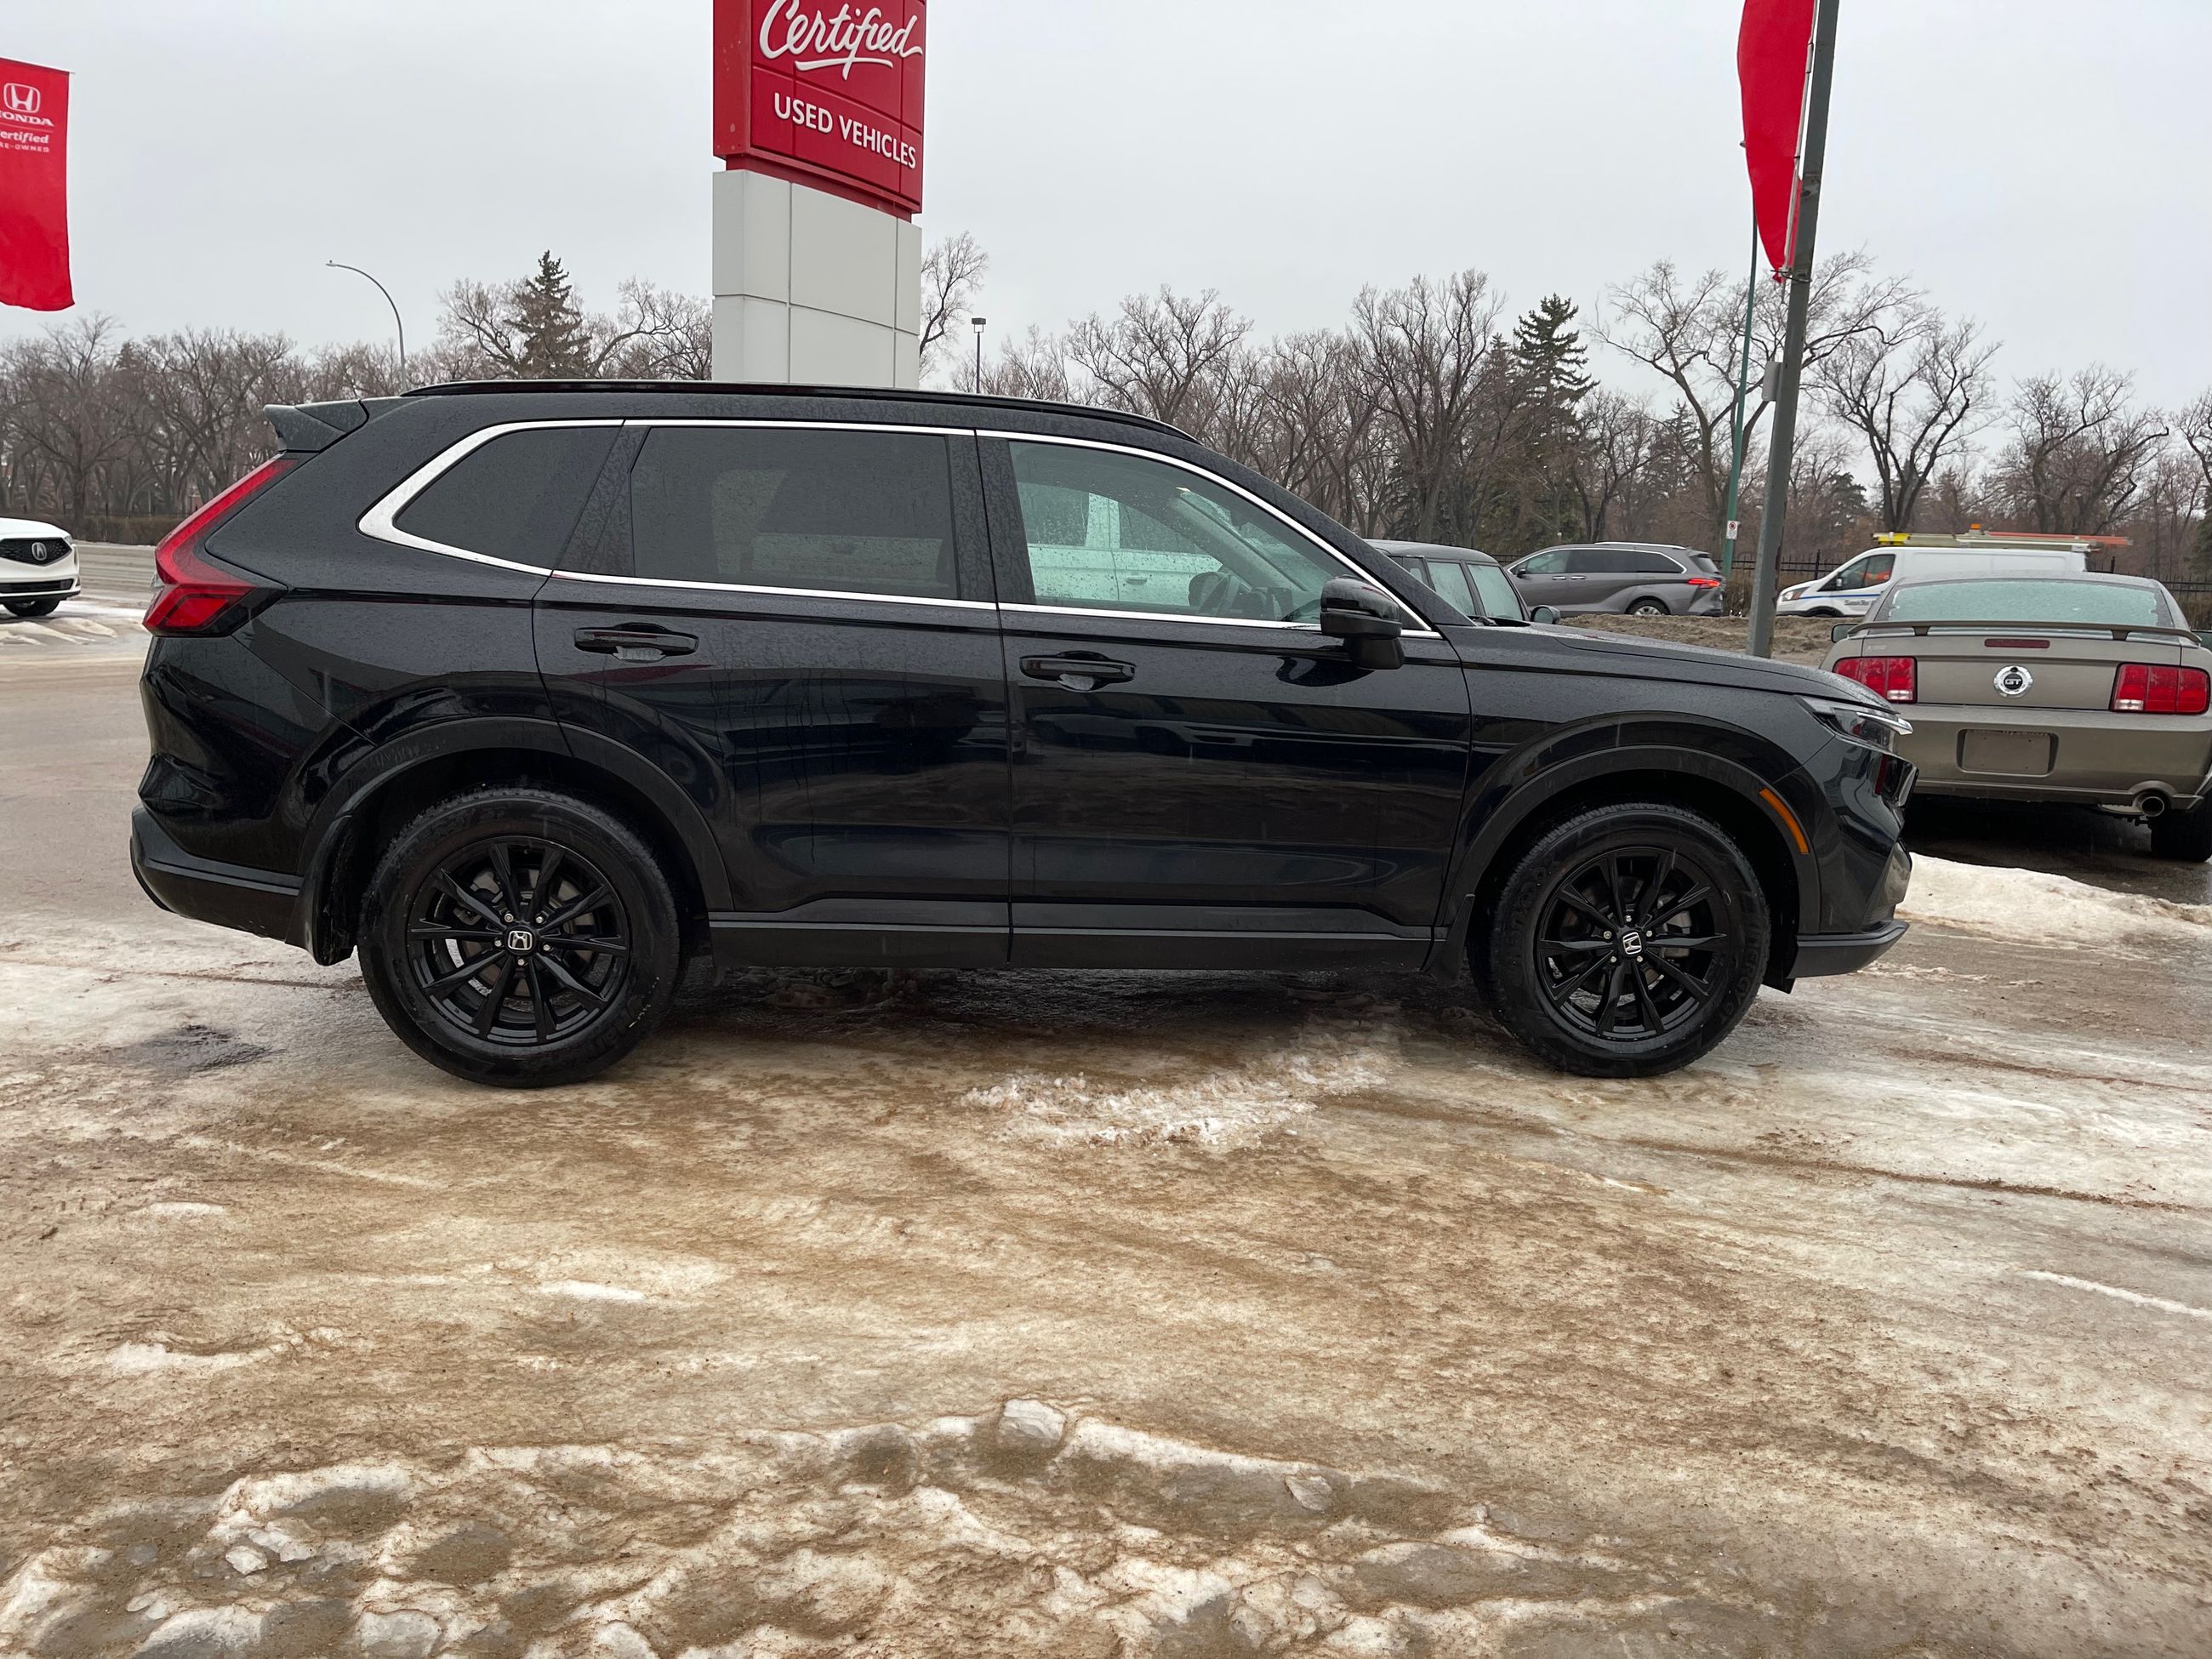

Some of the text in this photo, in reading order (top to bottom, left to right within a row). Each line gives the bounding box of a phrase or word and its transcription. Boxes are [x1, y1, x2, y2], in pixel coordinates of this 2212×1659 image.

[759, 0, 923, 80] Certified
[0, 130, 49, 143] ertified
[0, 142, 49, 152] RE-OWNED
[774, 92, 916, 169] USED VEHICLES
